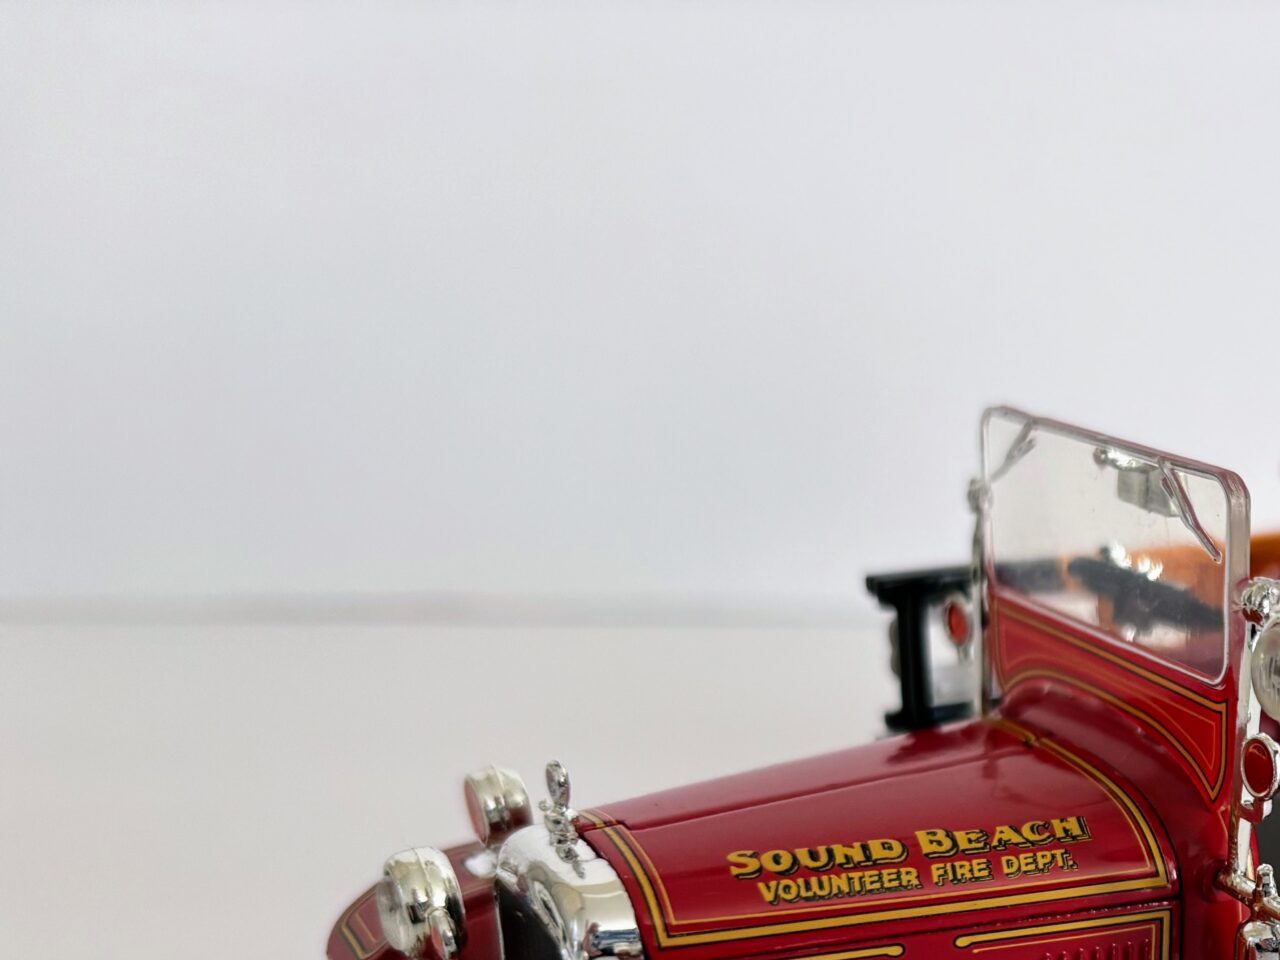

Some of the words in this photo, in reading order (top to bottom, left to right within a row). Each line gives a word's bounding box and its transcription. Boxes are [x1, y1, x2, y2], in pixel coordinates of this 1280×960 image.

[727, 838, 907, 877] SOUND
[915, 816, 1091, 857] BEACH
[757, 867, 923, 905] VOLUNTEER
[931, 858, 994, 886] FIRE
[1001, 849, 1078, 878] DEPT.
